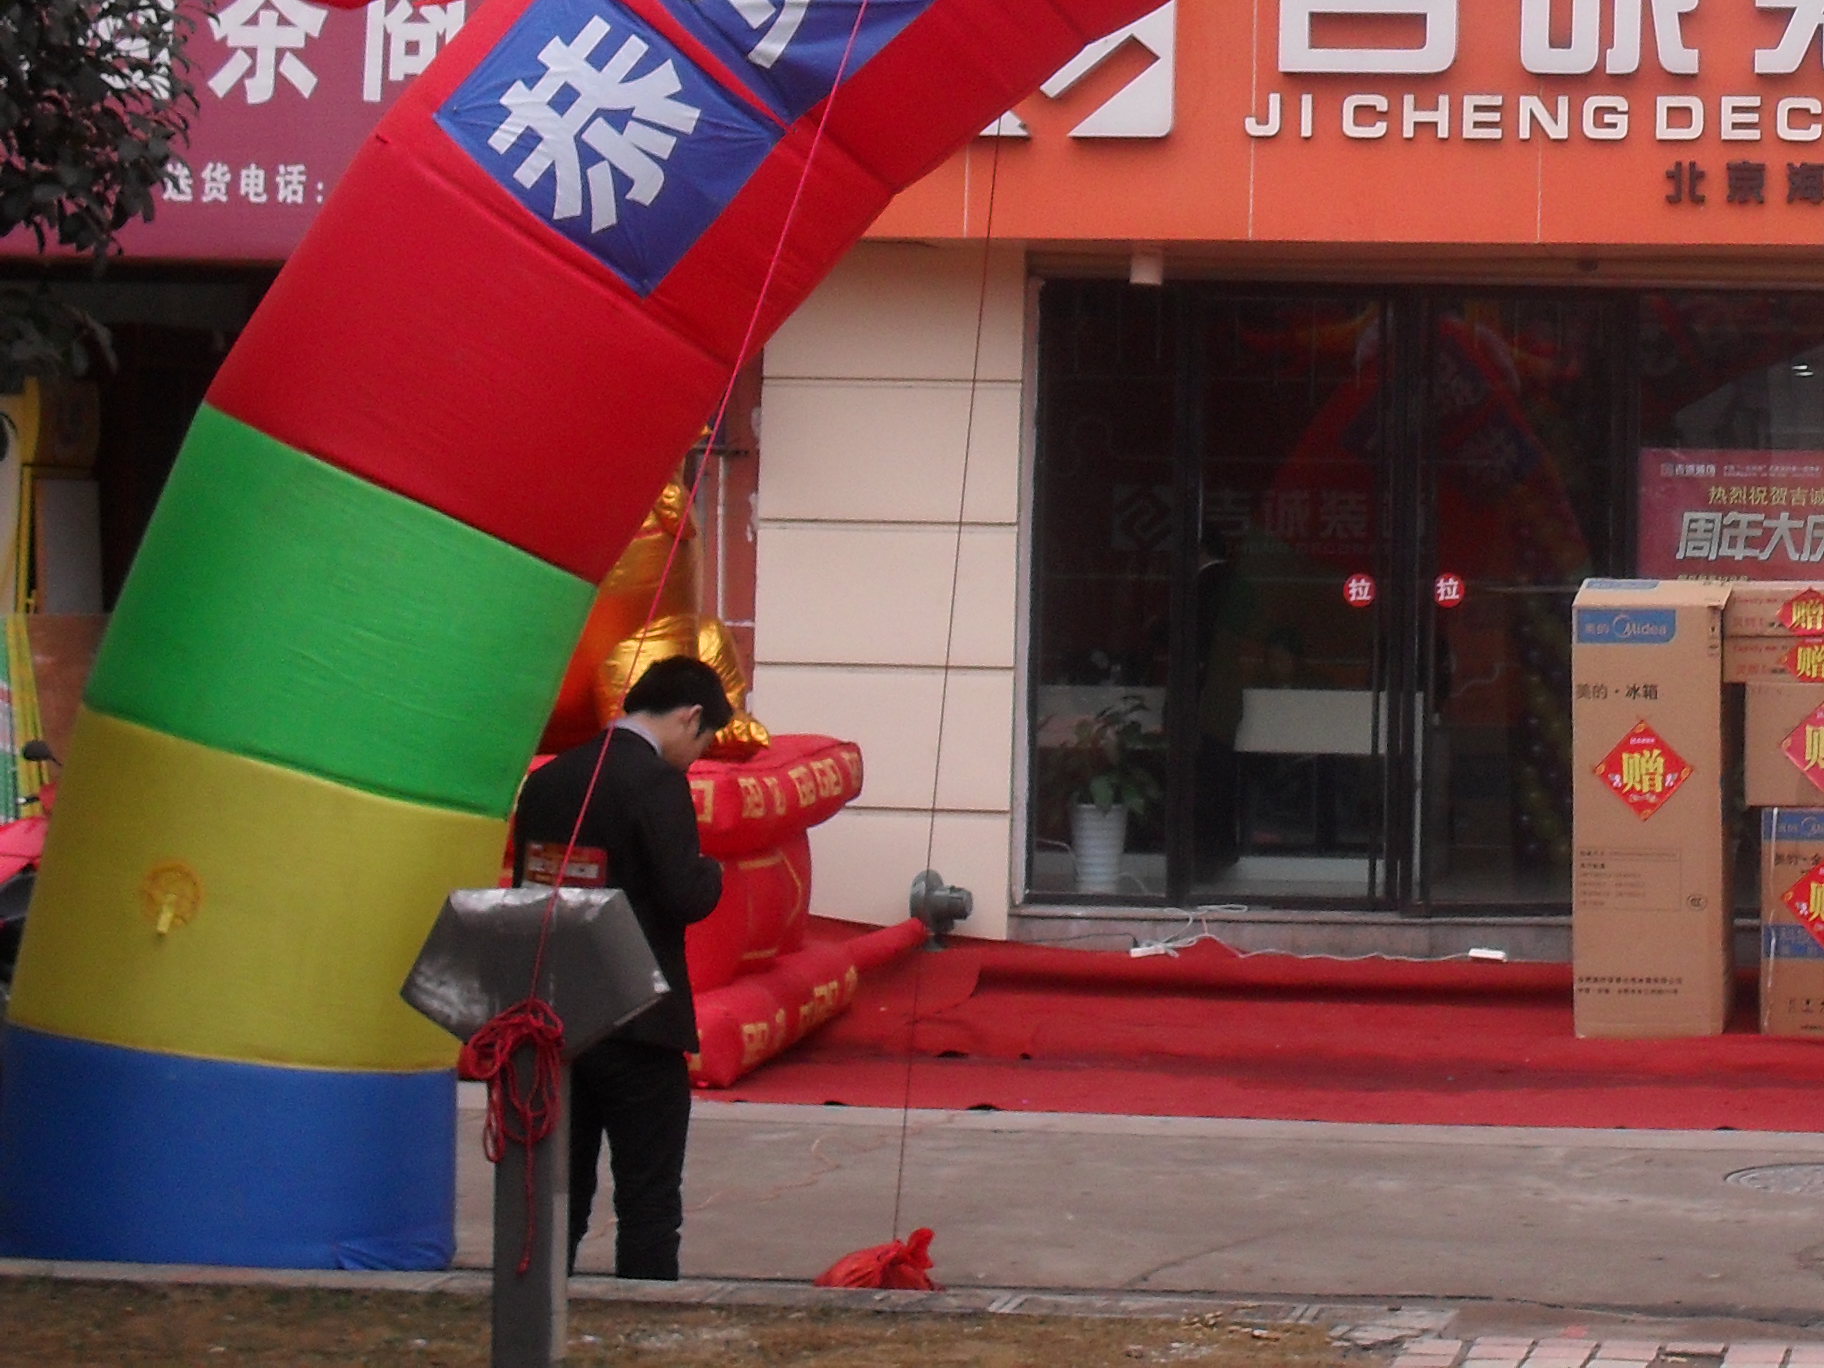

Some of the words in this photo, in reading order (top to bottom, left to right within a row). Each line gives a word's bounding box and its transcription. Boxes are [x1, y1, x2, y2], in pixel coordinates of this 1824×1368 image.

[1341, 93, 1630, 141] CHENG
[1348, 578, 1372, 602] 拉
[1436, 577, 1460, 602] 拉
[1792, 599, 1824, 630] 赠
[1623, 621, 1668, 637] Midea
[1622, 749, 1665, 793] 赠
